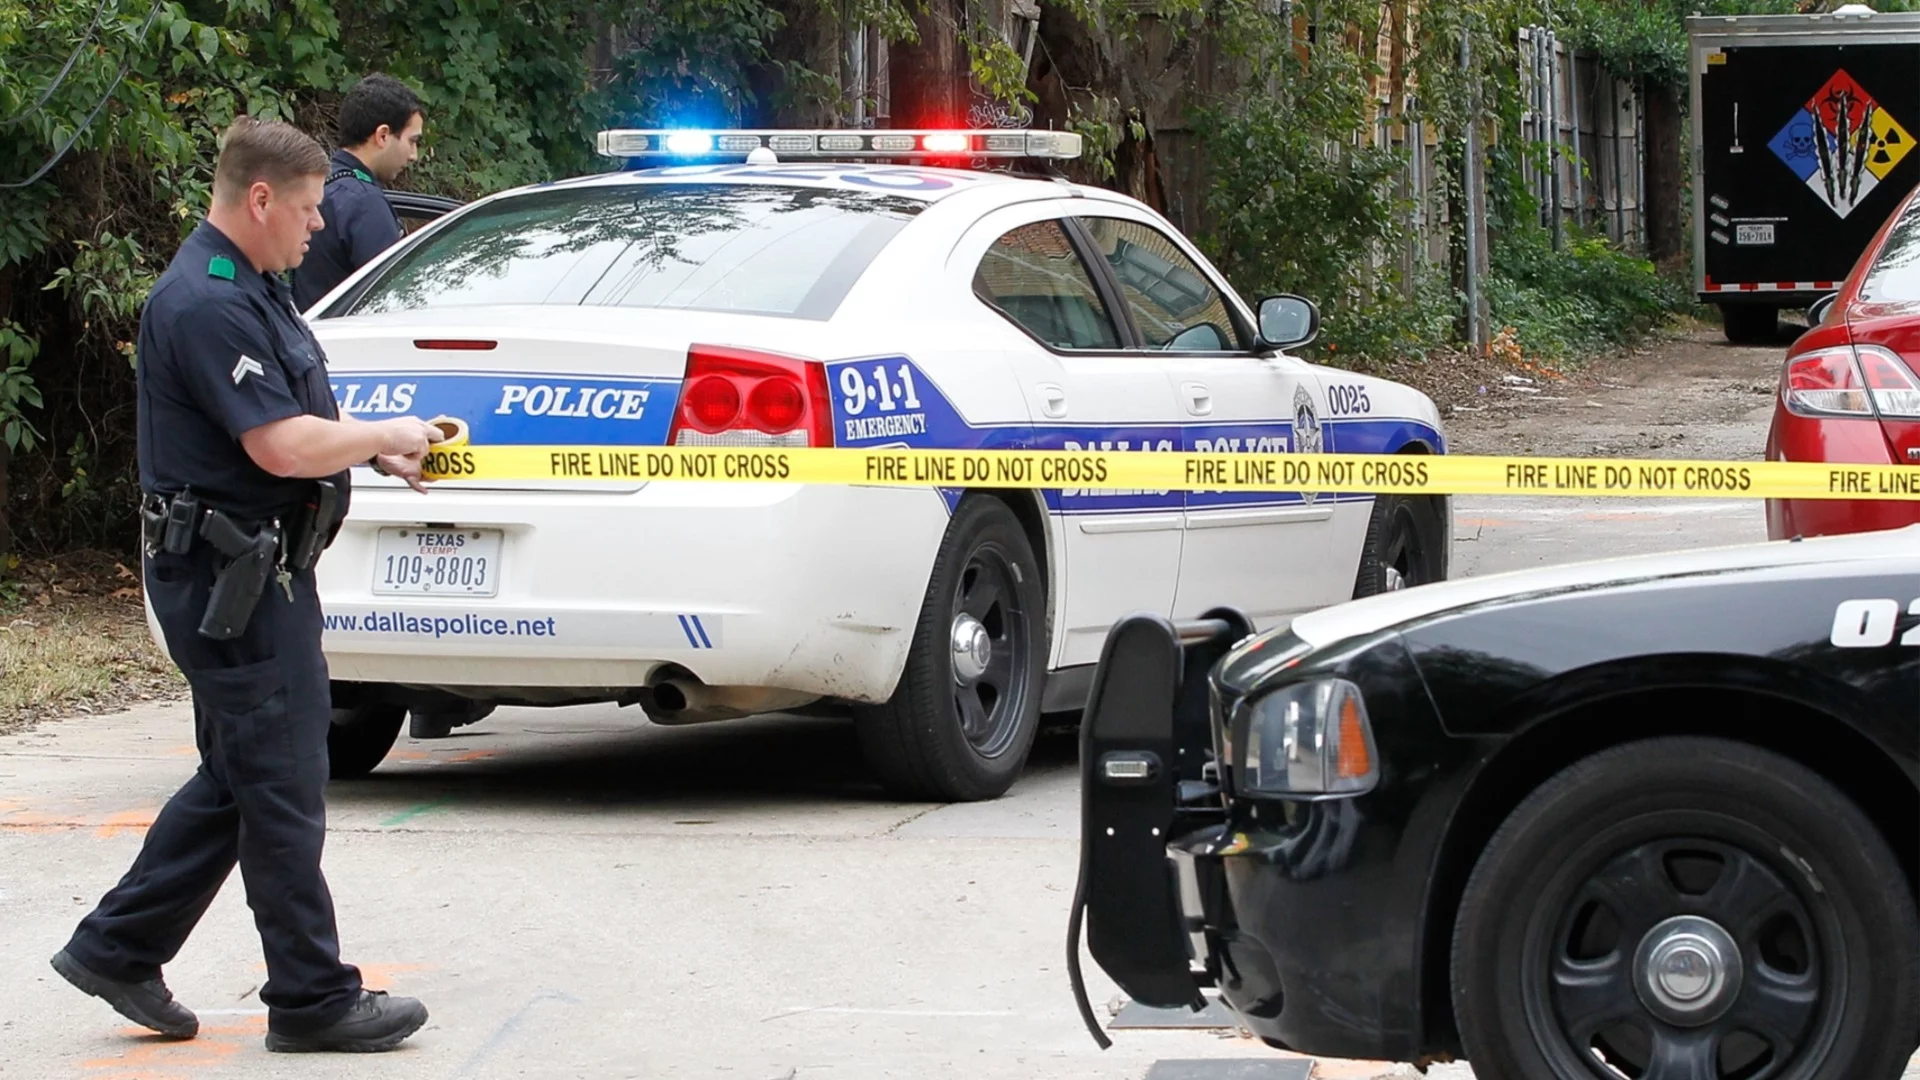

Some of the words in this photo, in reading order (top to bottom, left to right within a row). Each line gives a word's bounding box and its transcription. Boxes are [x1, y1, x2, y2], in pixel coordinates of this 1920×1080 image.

[332, 383, 417, 413] LAS
[495, 385, 650, 420] POLICE
[1328, 384, 1371, 415] 0025
[845, 413, 926, 441] EMERGENCY
[551, 453, 592, 476] FIRE
[599, 453, 640, 477] LINE
[647, 454, 674, 477] DO
[681, 454, 716, 478] NOT
[724, 454, 790, 479] CROSS
[866, 456, 907, 480] FIRE
[915, 457, 956, 481] LINE
[963, 457, 990, 481] DO
[997, 457, 1034, 482] NOT
[1041, 457, 1107, 482] CROSS
[1185, 460, 1227, 484] FIRE
[1234, 460, 1276, 485] LINE
[1283, 461, 1310, 485] DO
[1318, 461, 1355, 486] NOT
[1362, 461, 1428, 486] CROSS
[1506, 464, 1548, 488] FIRE
[1555, 465, 1597, 489] LINE
[1605, 466, 1632, 489] DO
[1639, 467, 1676, 490] NOT
[1684, 467, 1750, 491] CROSS
[1829, 471, 1871, 492] FIRE
[1879, 472, 1920, 493] LINE
[416, 533, 465, 547] TEXAS
[420, 546, 458, 555] EXEMPT
[323, 611, 556, 638] ww.dallaspolice.net
